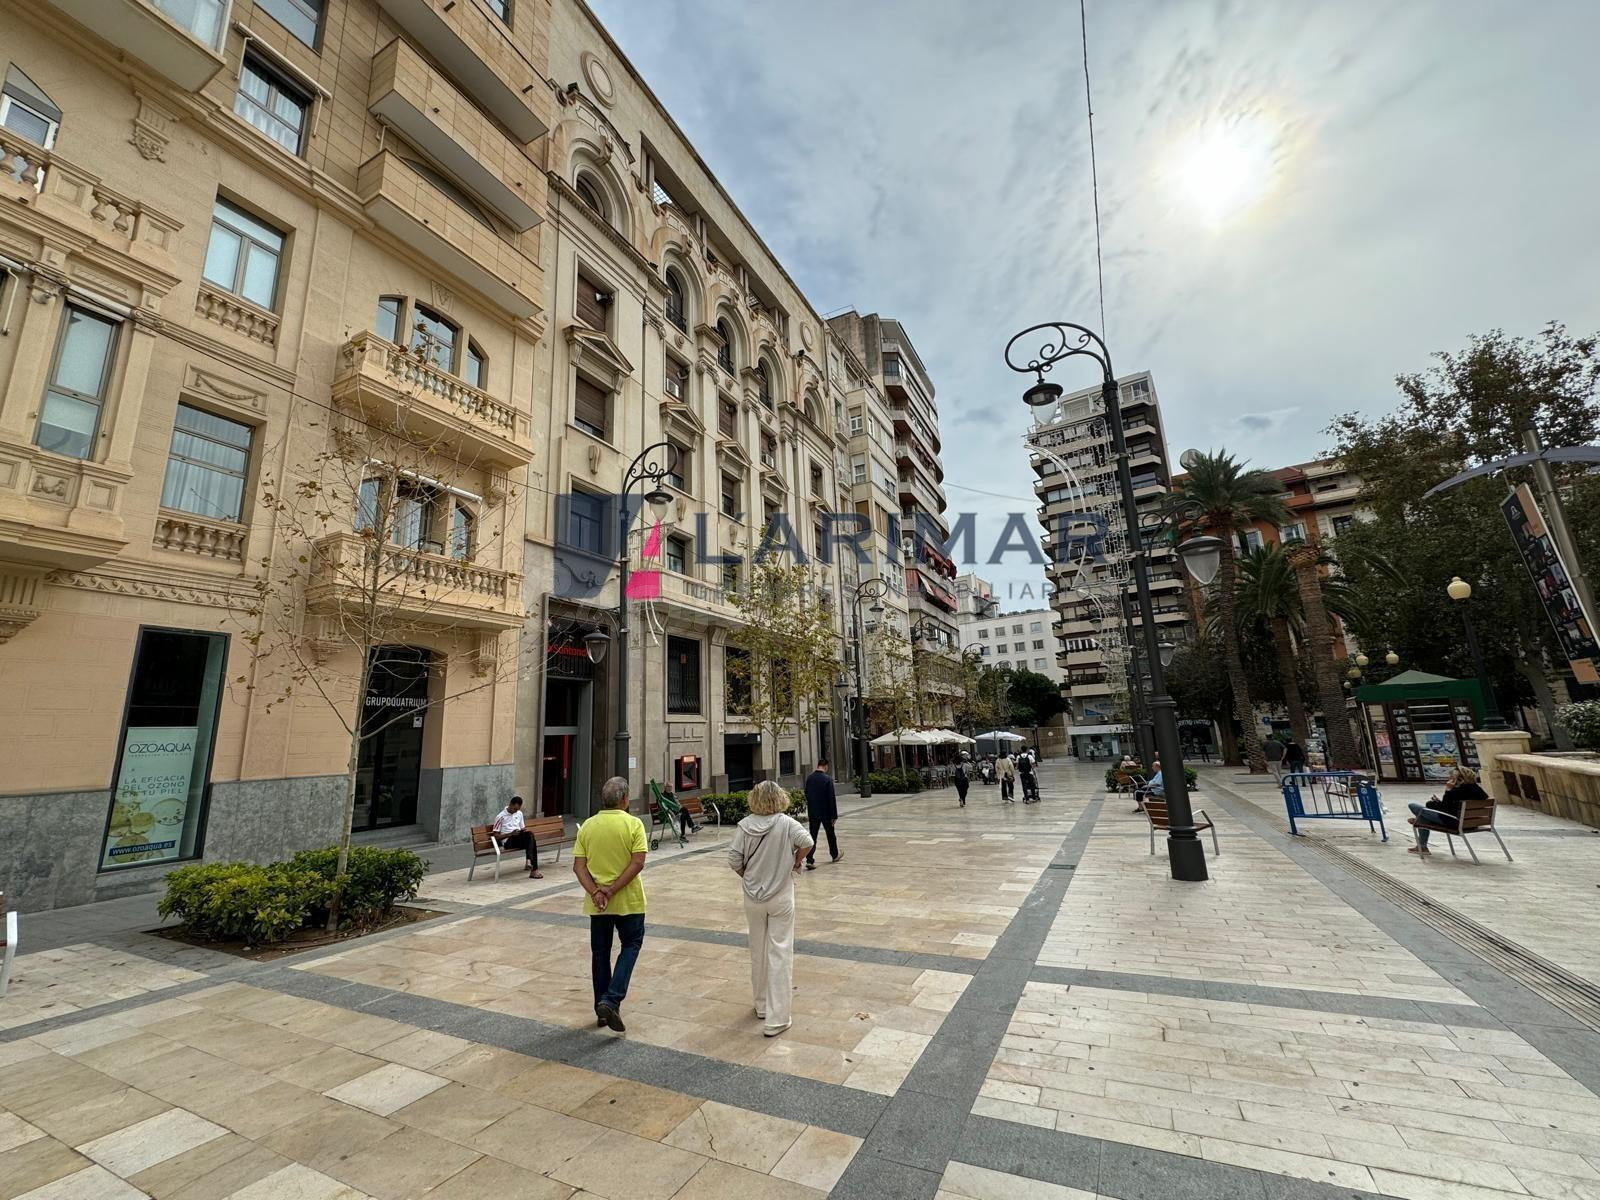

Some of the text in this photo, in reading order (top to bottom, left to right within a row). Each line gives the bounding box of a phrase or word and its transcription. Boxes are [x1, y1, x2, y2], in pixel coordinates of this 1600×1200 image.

[128, 743, 192, 754] OZOAQUA
[141, 775, 185, 783] EFICACIA
[147, 781, 185, 789] OZONO
[112, 841, 173, 855] www.ozoaqua.es
